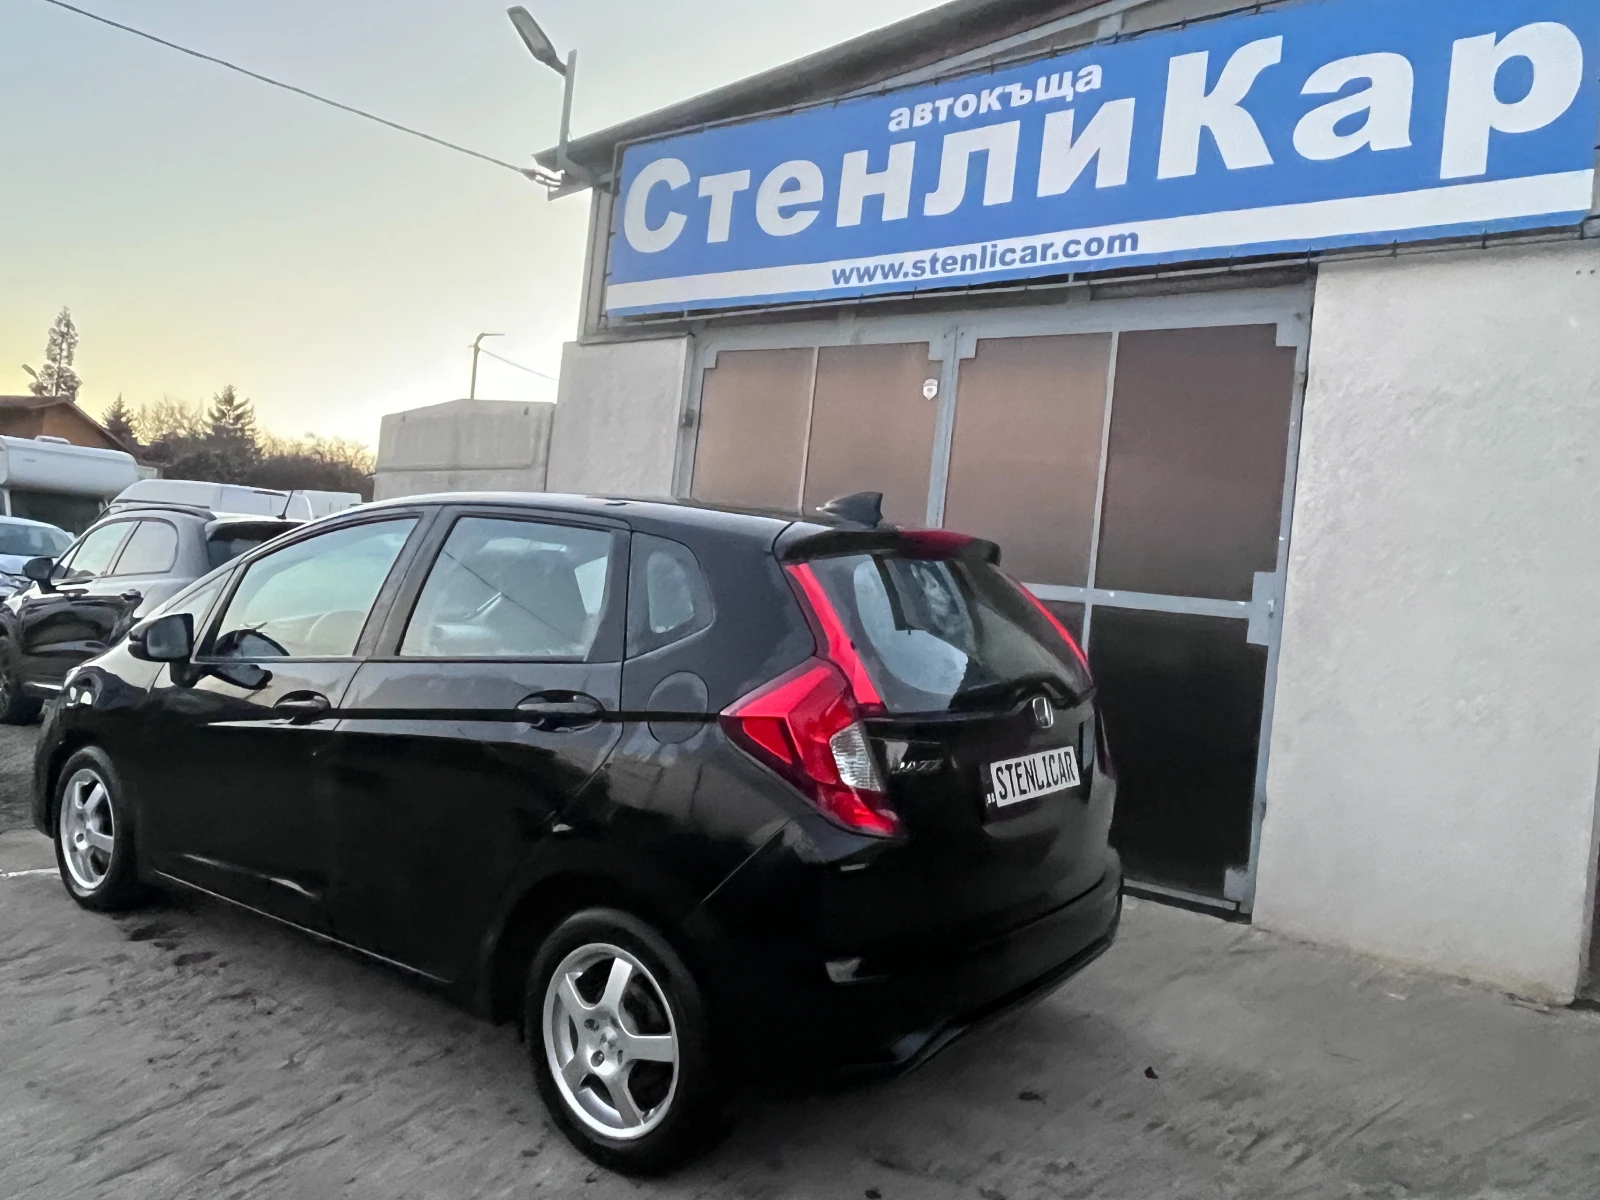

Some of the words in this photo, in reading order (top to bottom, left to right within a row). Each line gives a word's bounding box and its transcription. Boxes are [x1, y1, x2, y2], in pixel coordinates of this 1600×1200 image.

[888, 64, 1102, 132] автокъща
[832, 232, 1139, 285] www.stenlicar.com
[996, 751, 1076, 800] STENLICAR
